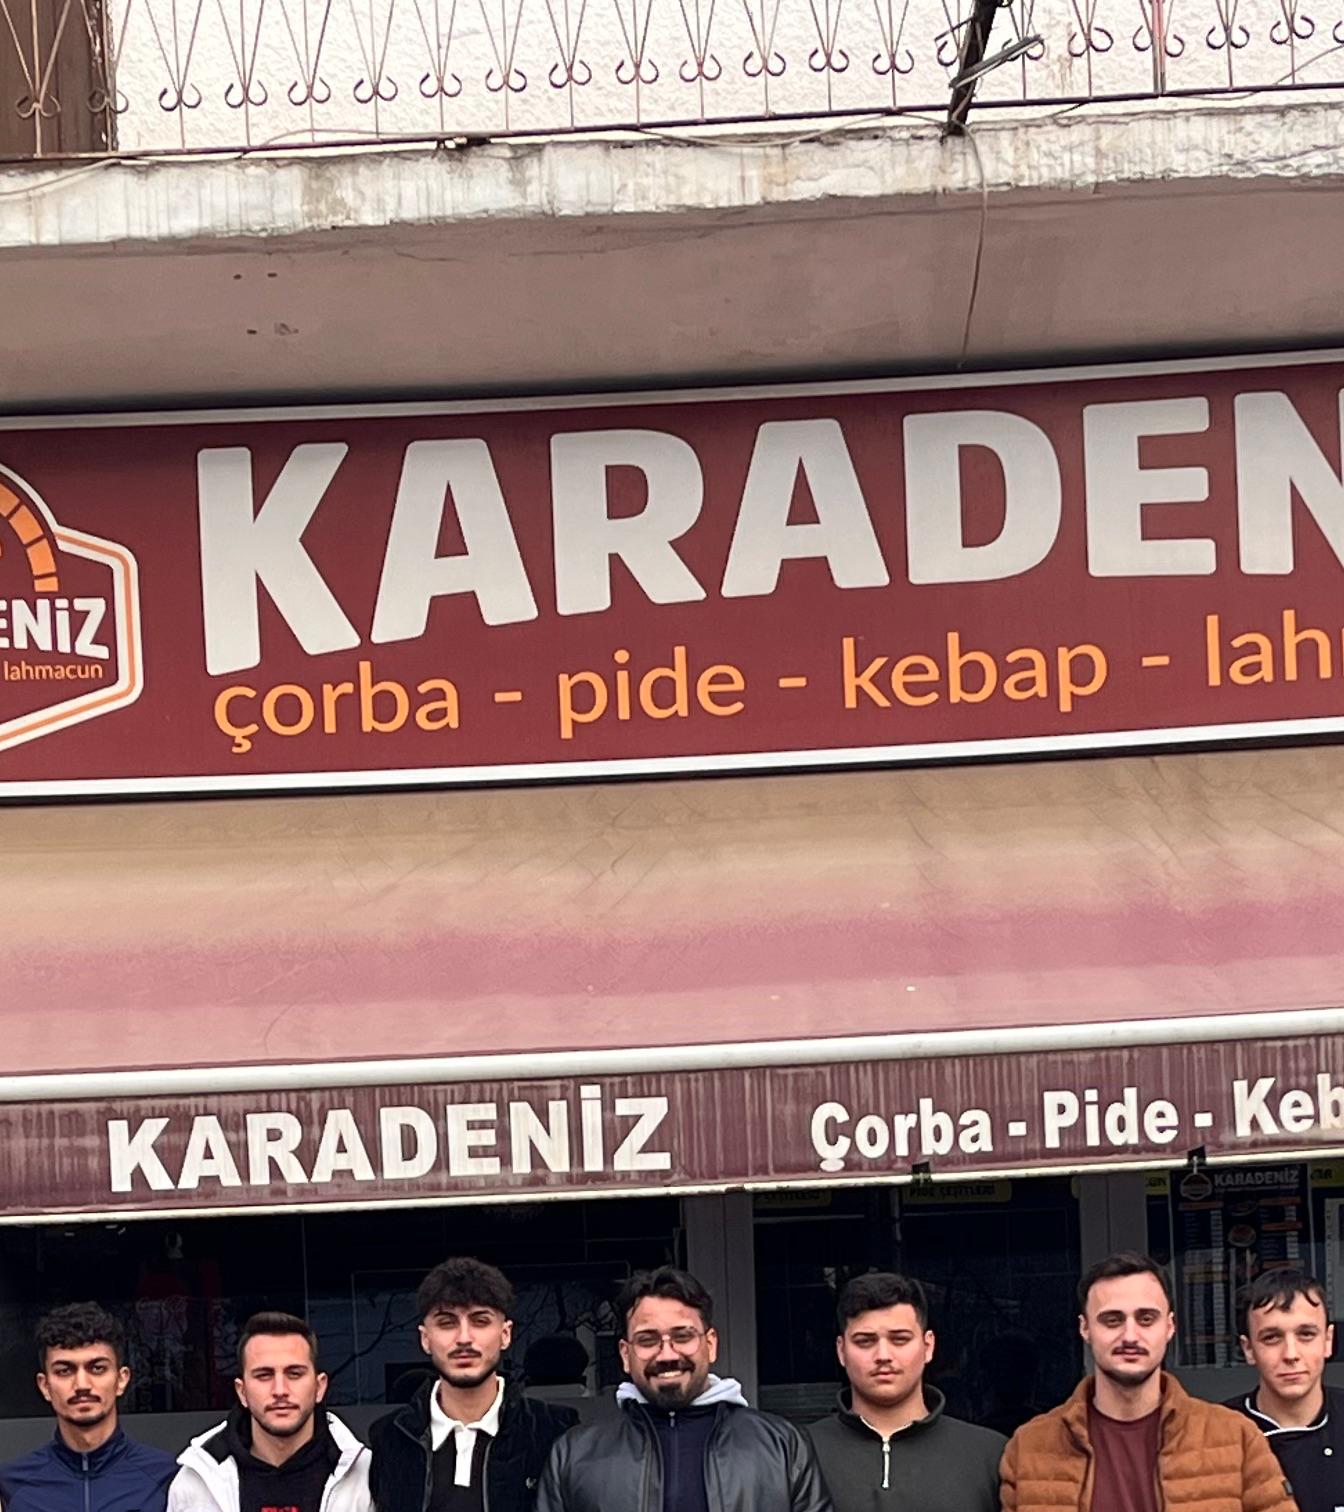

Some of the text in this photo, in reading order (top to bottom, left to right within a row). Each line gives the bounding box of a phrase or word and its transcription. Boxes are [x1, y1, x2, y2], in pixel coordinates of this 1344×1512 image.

[4, 661, 104, 682] lahmacun
[214, 661, 459, 753] çorba
[556, 648, 747, 738] pide
[842, 629, 1108, 714] kebap
[107, 1085, 671, 1192] KARADENİZ
[811, 1097, 993, 1172] Çorba
[1044, 1087, 1177, 1149] Pide
